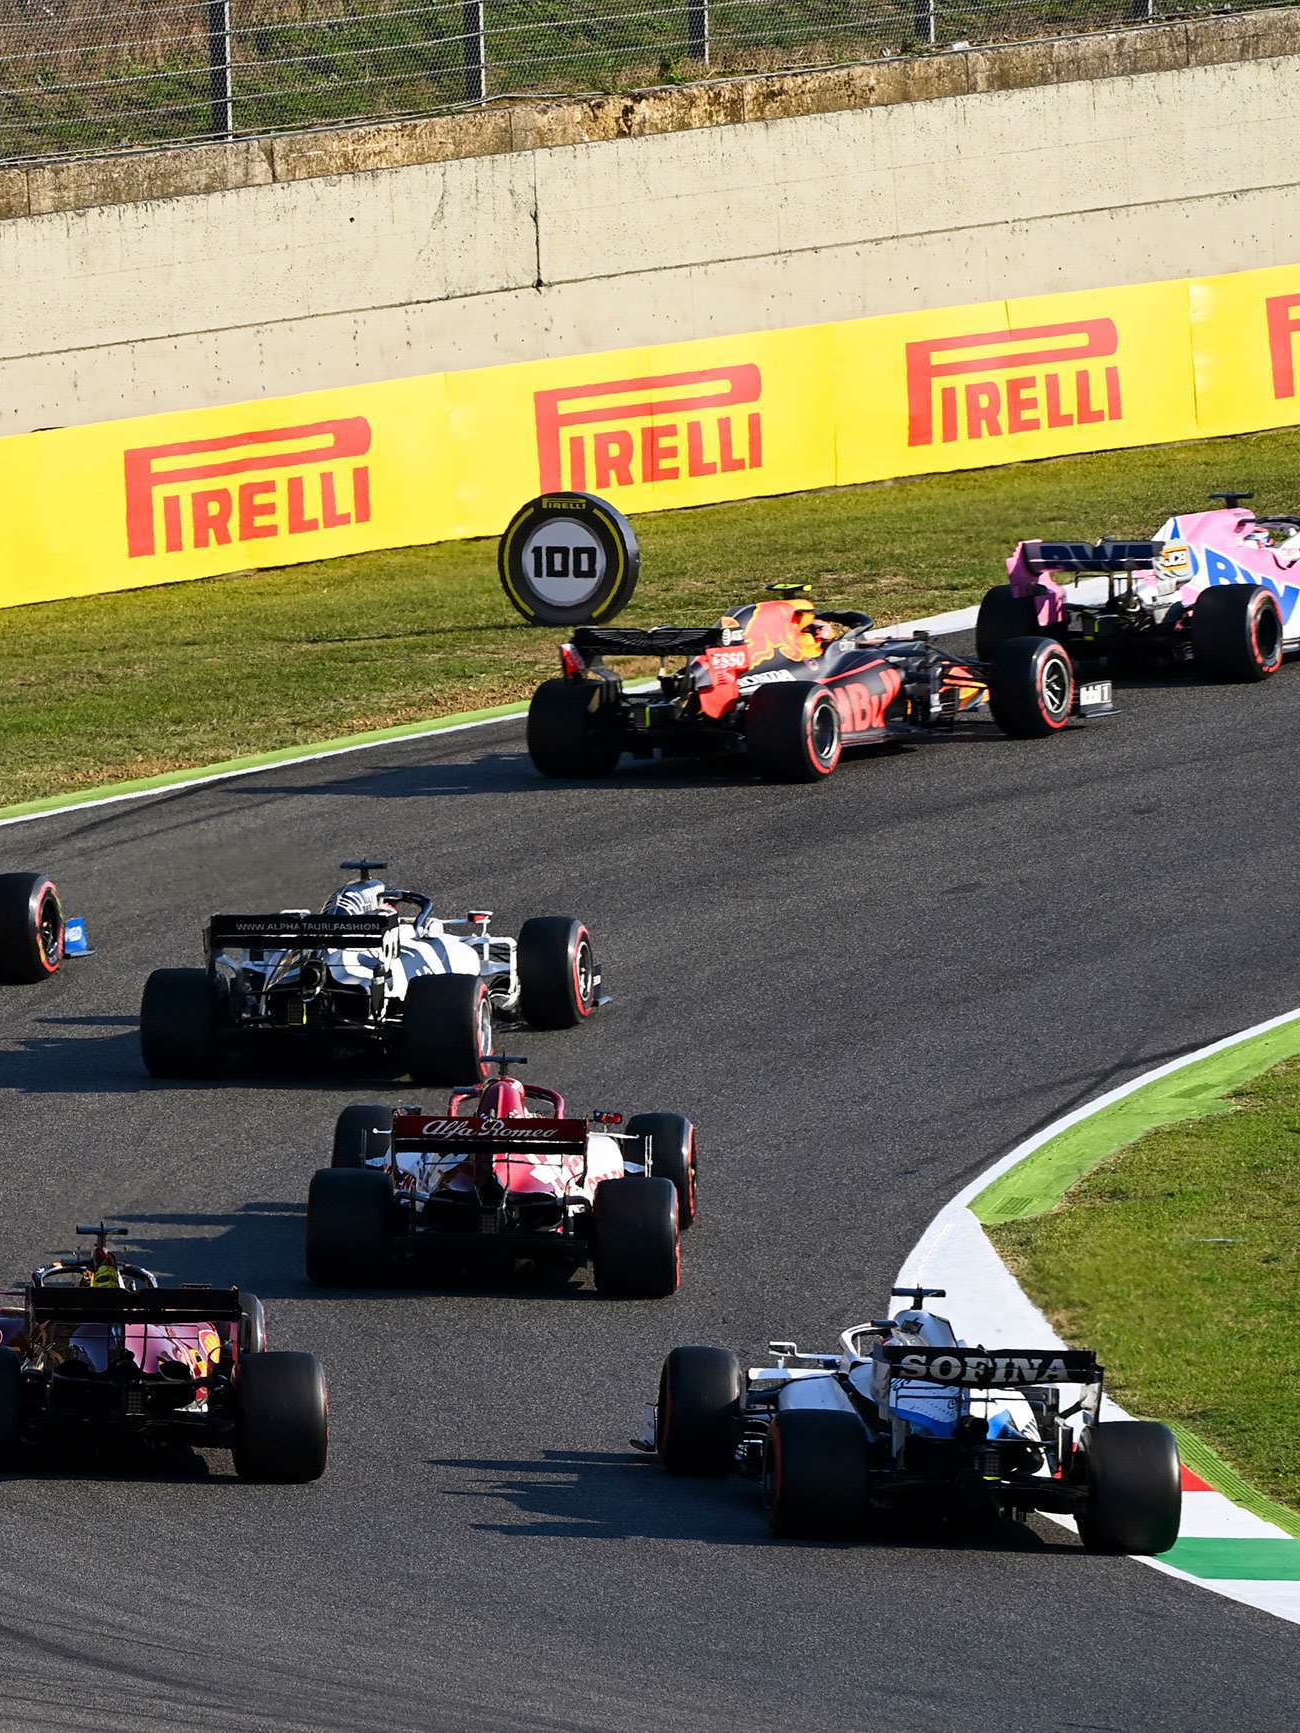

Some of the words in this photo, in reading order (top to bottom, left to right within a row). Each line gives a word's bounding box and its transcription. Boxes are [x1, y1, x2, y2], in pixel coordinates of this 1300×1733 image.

[906, 317, 1122, 447] PIRELLI
[534, 363, 762, 494] PIRELLI
[124, 416, 371, 558] PIRELLI
[541, 497, 587, 510] PIRELLI
[531, 546, 597, 578] 100
[421, 1119, 477, 1139] Alfa
[479, 1119, 559, 1138] Romeo
[900, 1354, 1071, 1383] SOFINA
